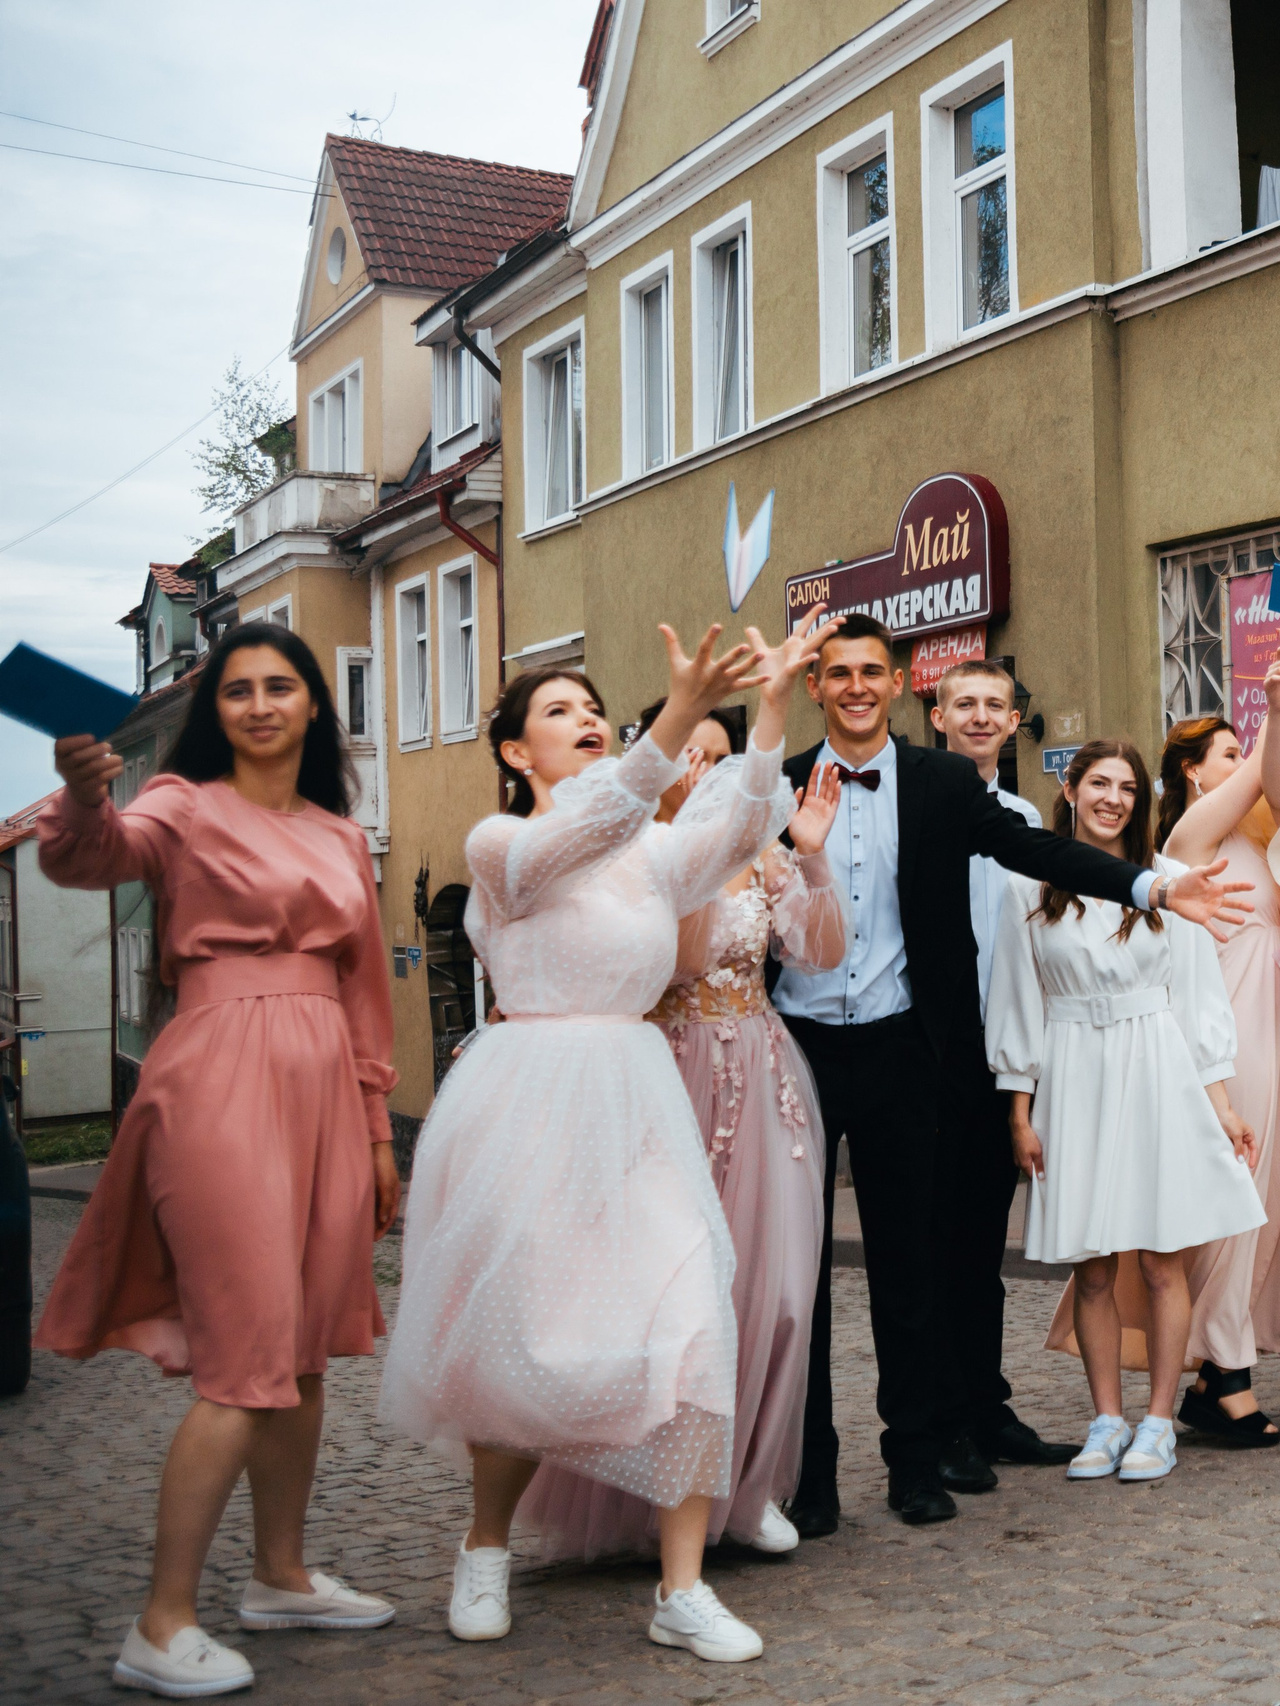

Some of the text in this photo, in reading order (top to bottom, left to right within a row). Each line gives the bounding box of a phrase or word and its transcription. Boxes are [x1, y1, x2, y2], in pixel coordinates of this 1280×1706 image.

[901, 508, 971, 576] Май
[788, 577, 830, 608] САЛОН
[793, 574, 981, 636] АХЕРСКАЯ
[917, 630, 983, 663] АРЕНДА
[1245, 632, 1278, 646] Магазин
[922, 668, 928, 680] 8
[929, 666, 940, 680] 911
